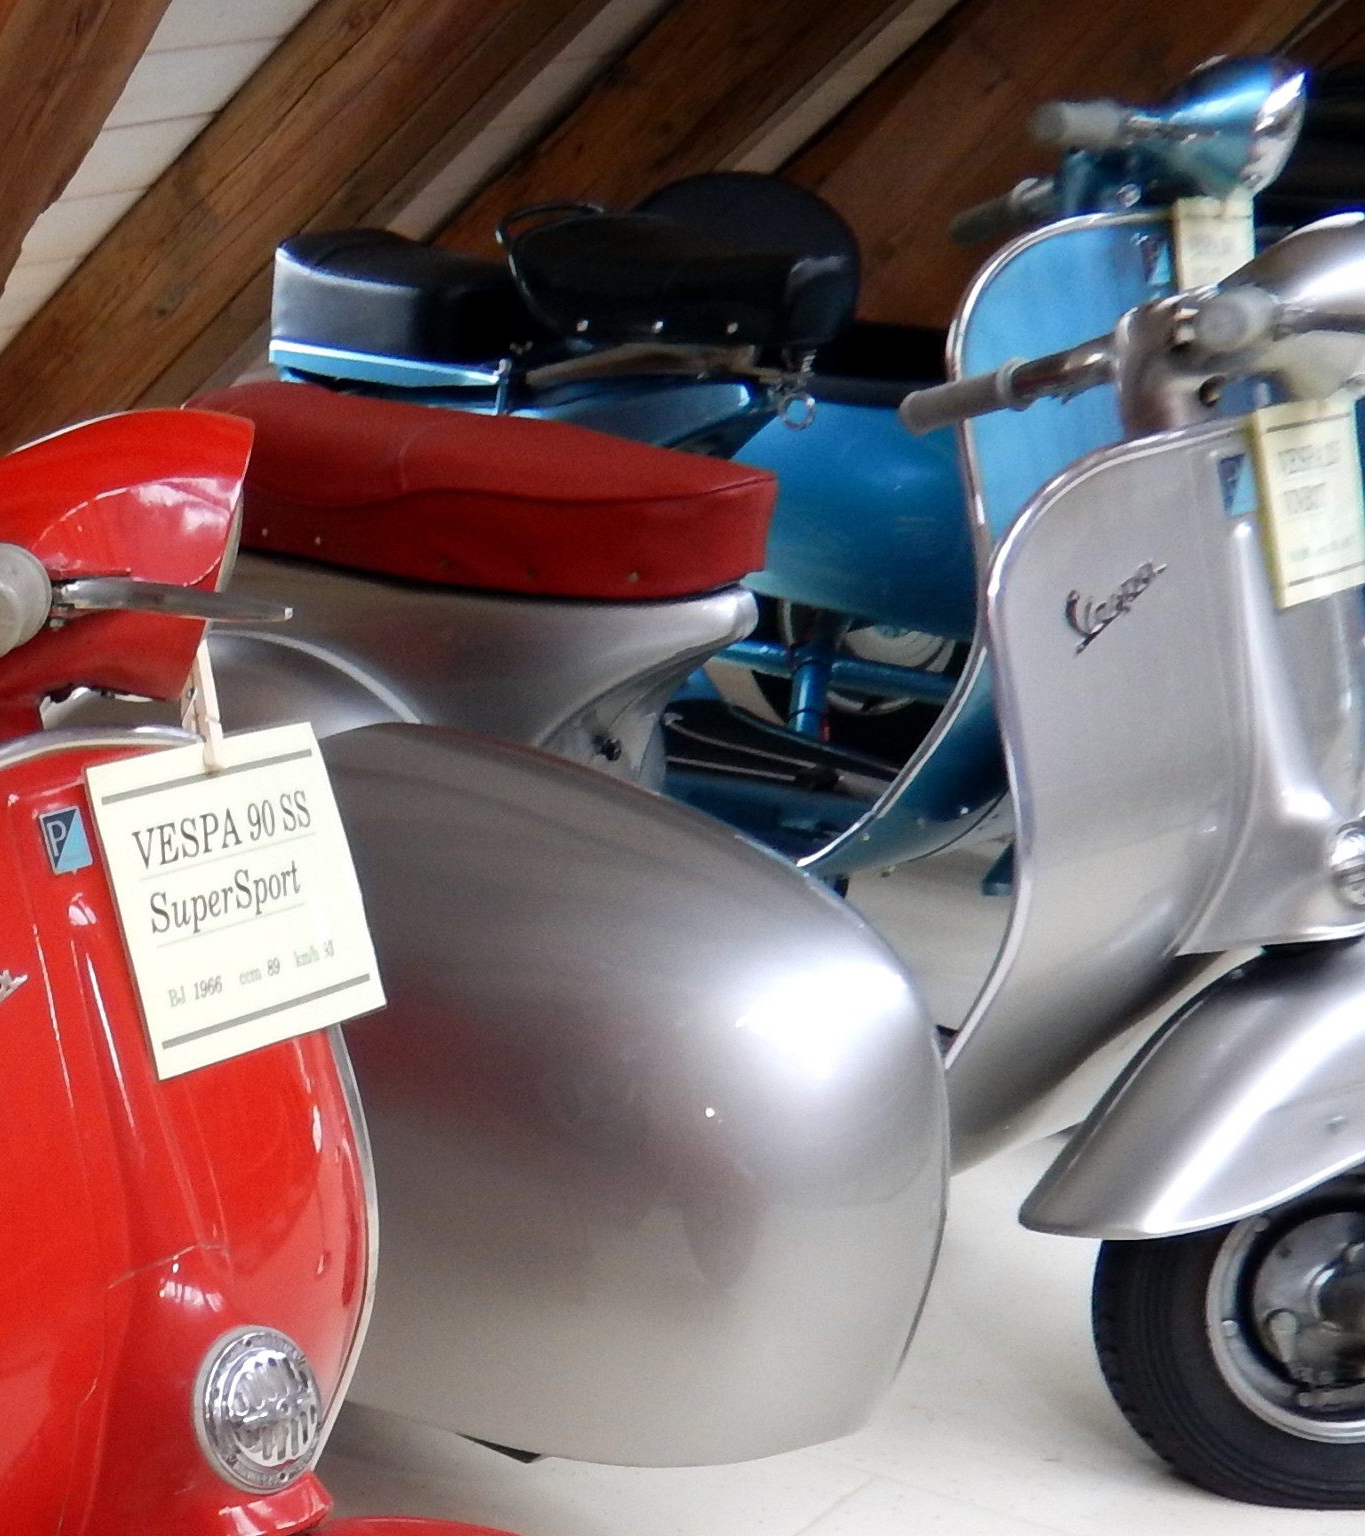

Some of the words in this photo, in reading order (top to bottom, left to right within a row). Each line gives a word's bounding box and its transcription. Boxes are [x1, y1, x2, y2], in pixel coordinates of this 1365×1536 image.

[47, 820, 66, 857] P
[132, 807, 242, 870] VESPA
[246, 798, 275, 842] 90
[278, 789, 312, 833] SS
[149, 860, 302, 935] SuperSport
[193, 975, 223, 1000] 1966
[266, 957, 281, 976] 89
